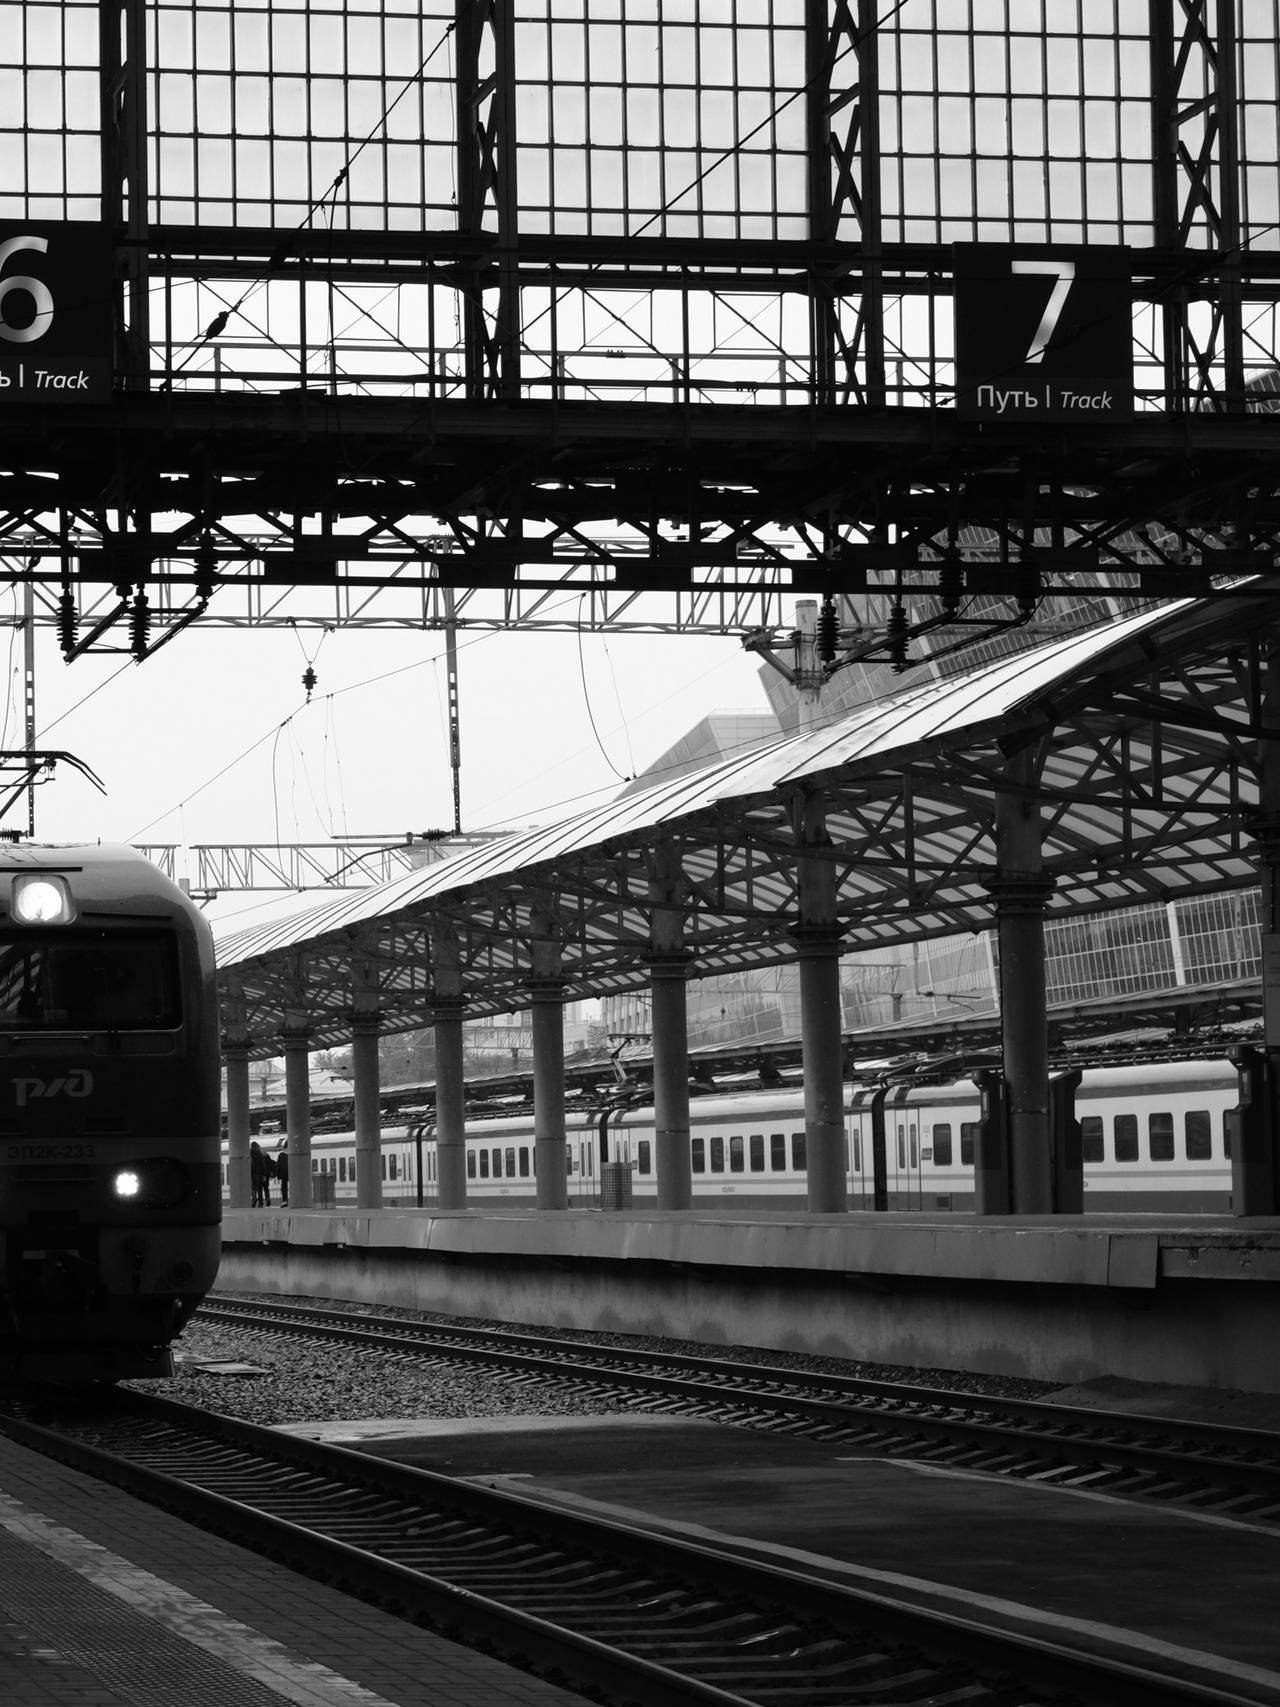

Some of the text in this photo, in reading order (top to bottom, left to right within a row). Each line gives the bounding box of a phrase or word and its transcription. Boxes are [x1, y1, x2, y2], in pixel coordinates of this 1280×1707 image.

[1011, 260, 1076, 364] 7
[34, 370, 90, 389] Track
[977, 384, 1113, 414] Путь Track
[8, 1144, 95, 1159] ЭП2К-233
